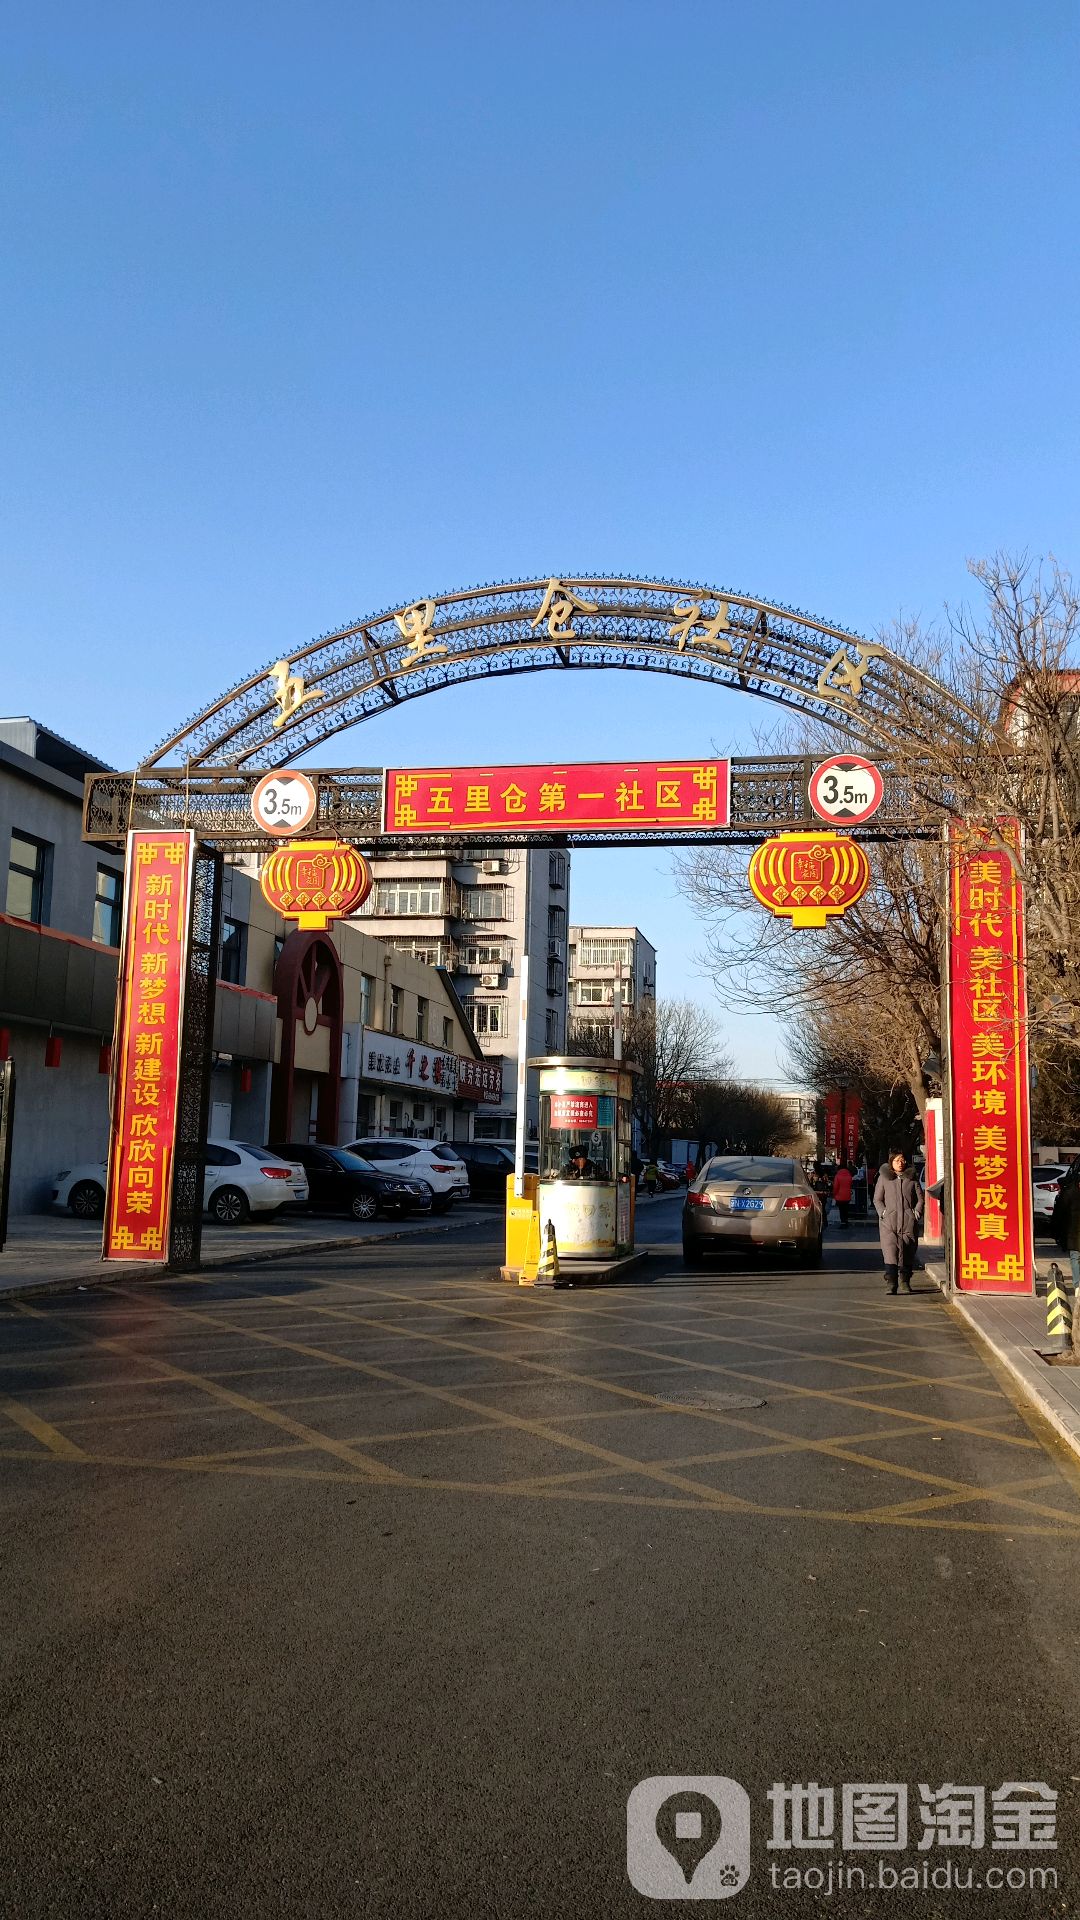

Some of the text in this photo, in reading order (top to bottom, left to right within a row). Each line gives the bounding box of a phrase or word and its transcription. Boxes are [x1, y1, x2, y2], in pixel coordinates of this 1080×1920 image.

[263, 788, 302, 816] 3.5m
[427, 780, 681, 814] 五里仓第一社区
[822, 775, 868, 805] 3.5m
[126, 873, 173, 1214] 新时代 新梦想 新建设 欣欣向荣
[968, 859, 1010, 1242] 美时代 美社区 美环境 美梦成真
